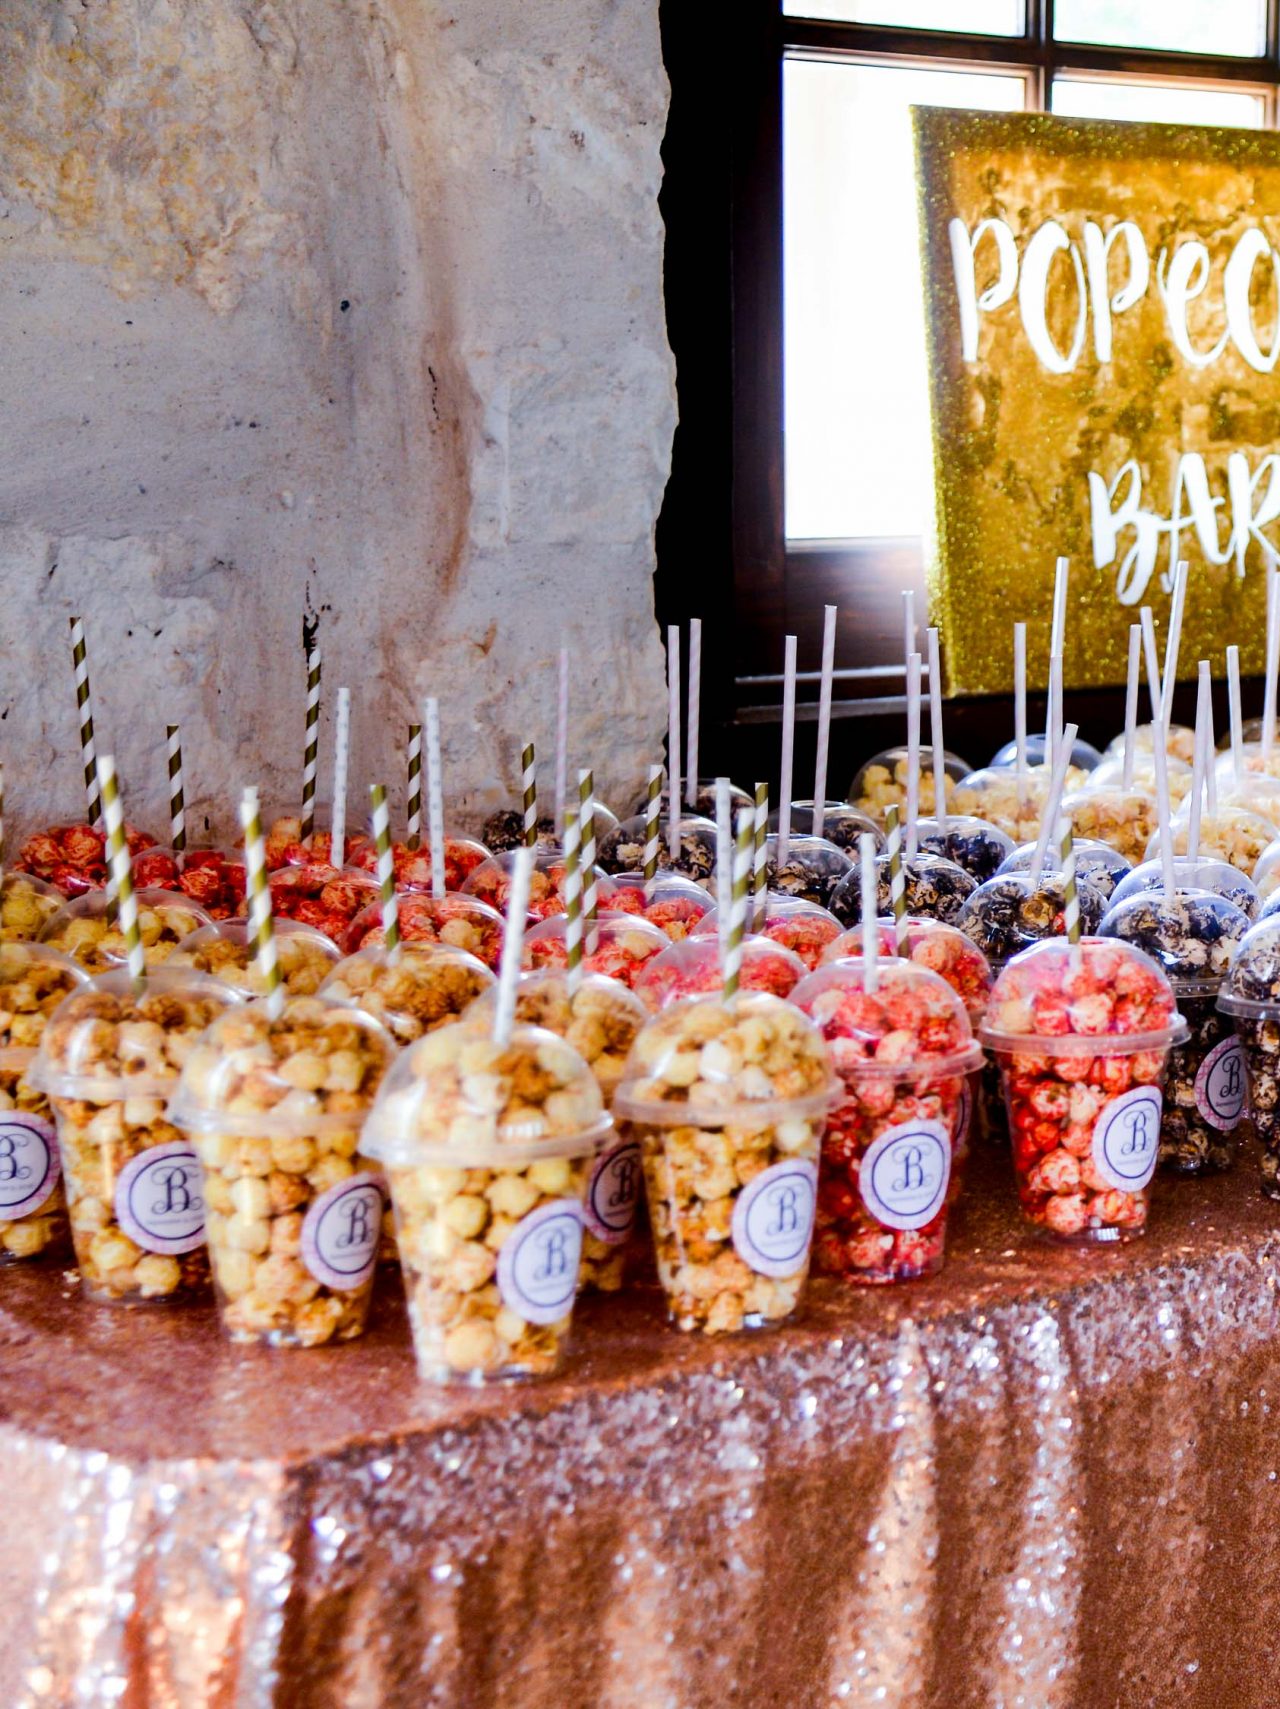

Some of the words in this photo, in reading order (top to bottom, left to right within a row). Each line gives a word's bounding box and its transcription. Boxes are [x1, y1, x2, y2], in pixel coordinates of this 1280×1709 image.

[1219, 1054, 1243, 1098] B
[1119, 1107, 1154, 1156] B
[151, 1163, 204, 1216] B
[891, 1141, 936, 1192] B
[335, 1193, 376, 1249] B
[766, 1183, 807, 1237] B
